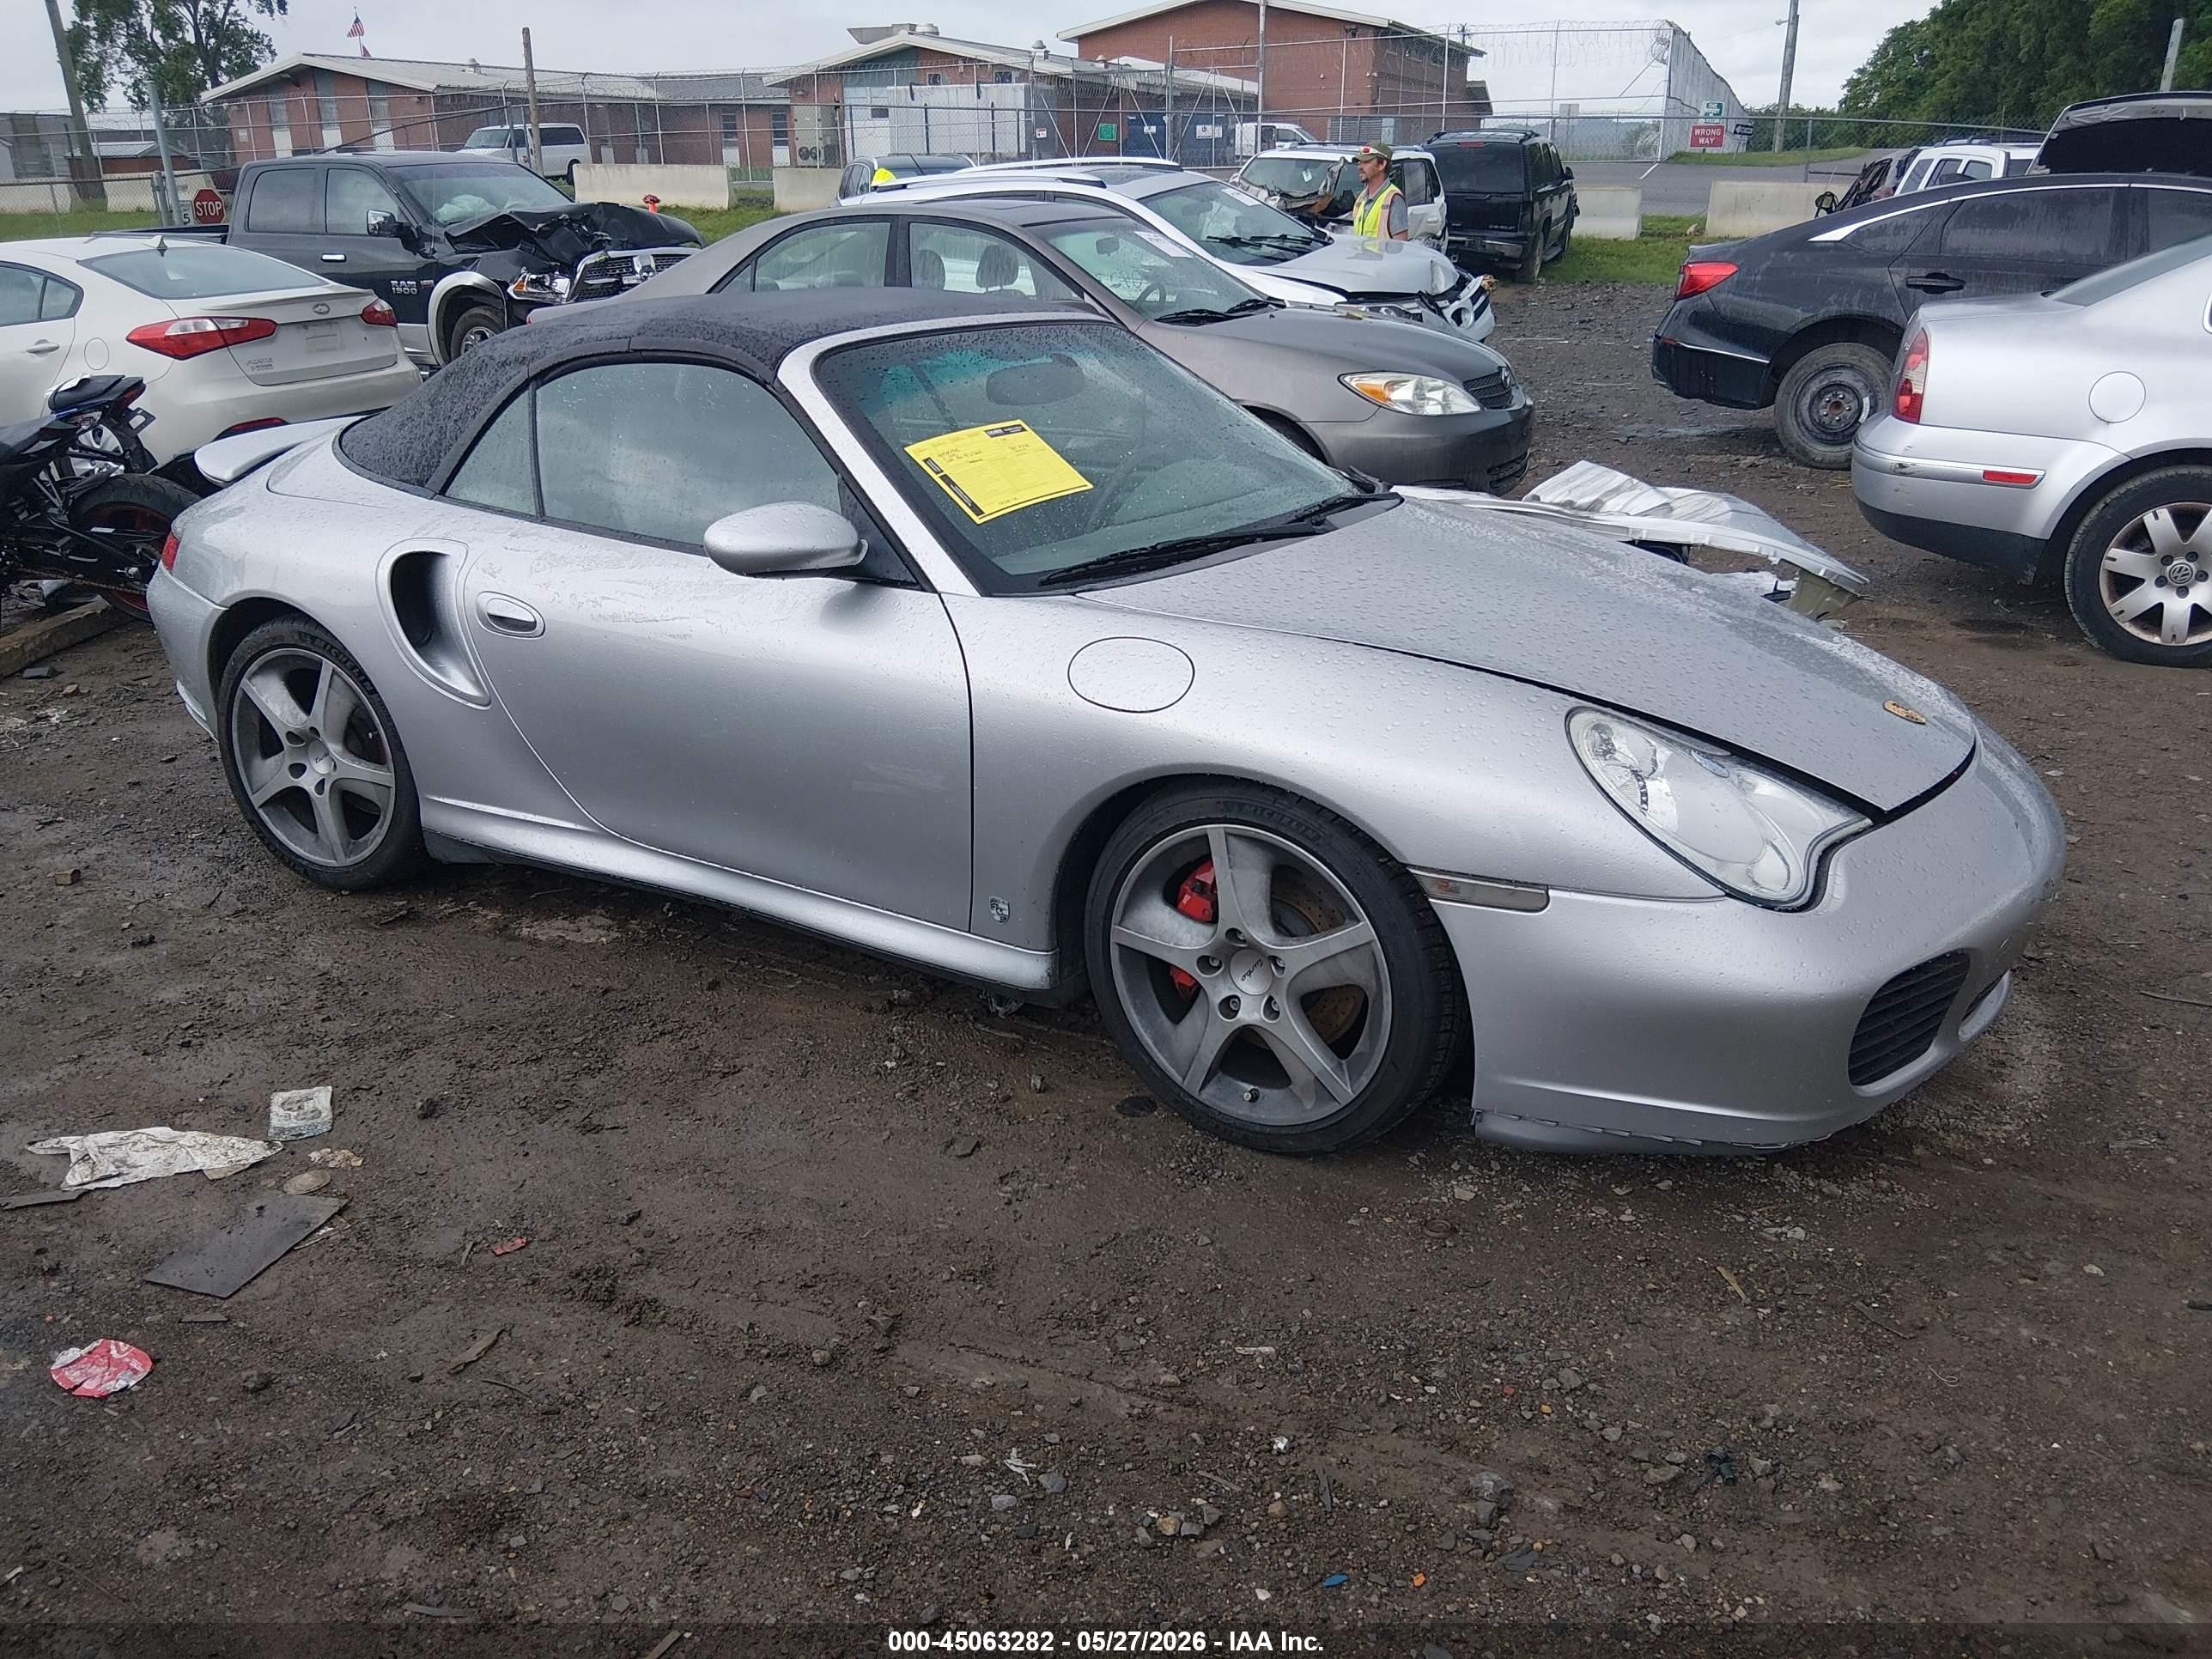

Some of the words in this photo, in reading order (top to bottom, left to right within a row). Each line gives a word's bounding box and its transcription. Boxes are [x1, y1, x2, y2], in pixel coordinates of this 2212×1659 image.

[1694, 128, 1722, 137] WRONG
[1698, 137, 1716, 145] WAY
[195, 201, 222, 216] STOP
